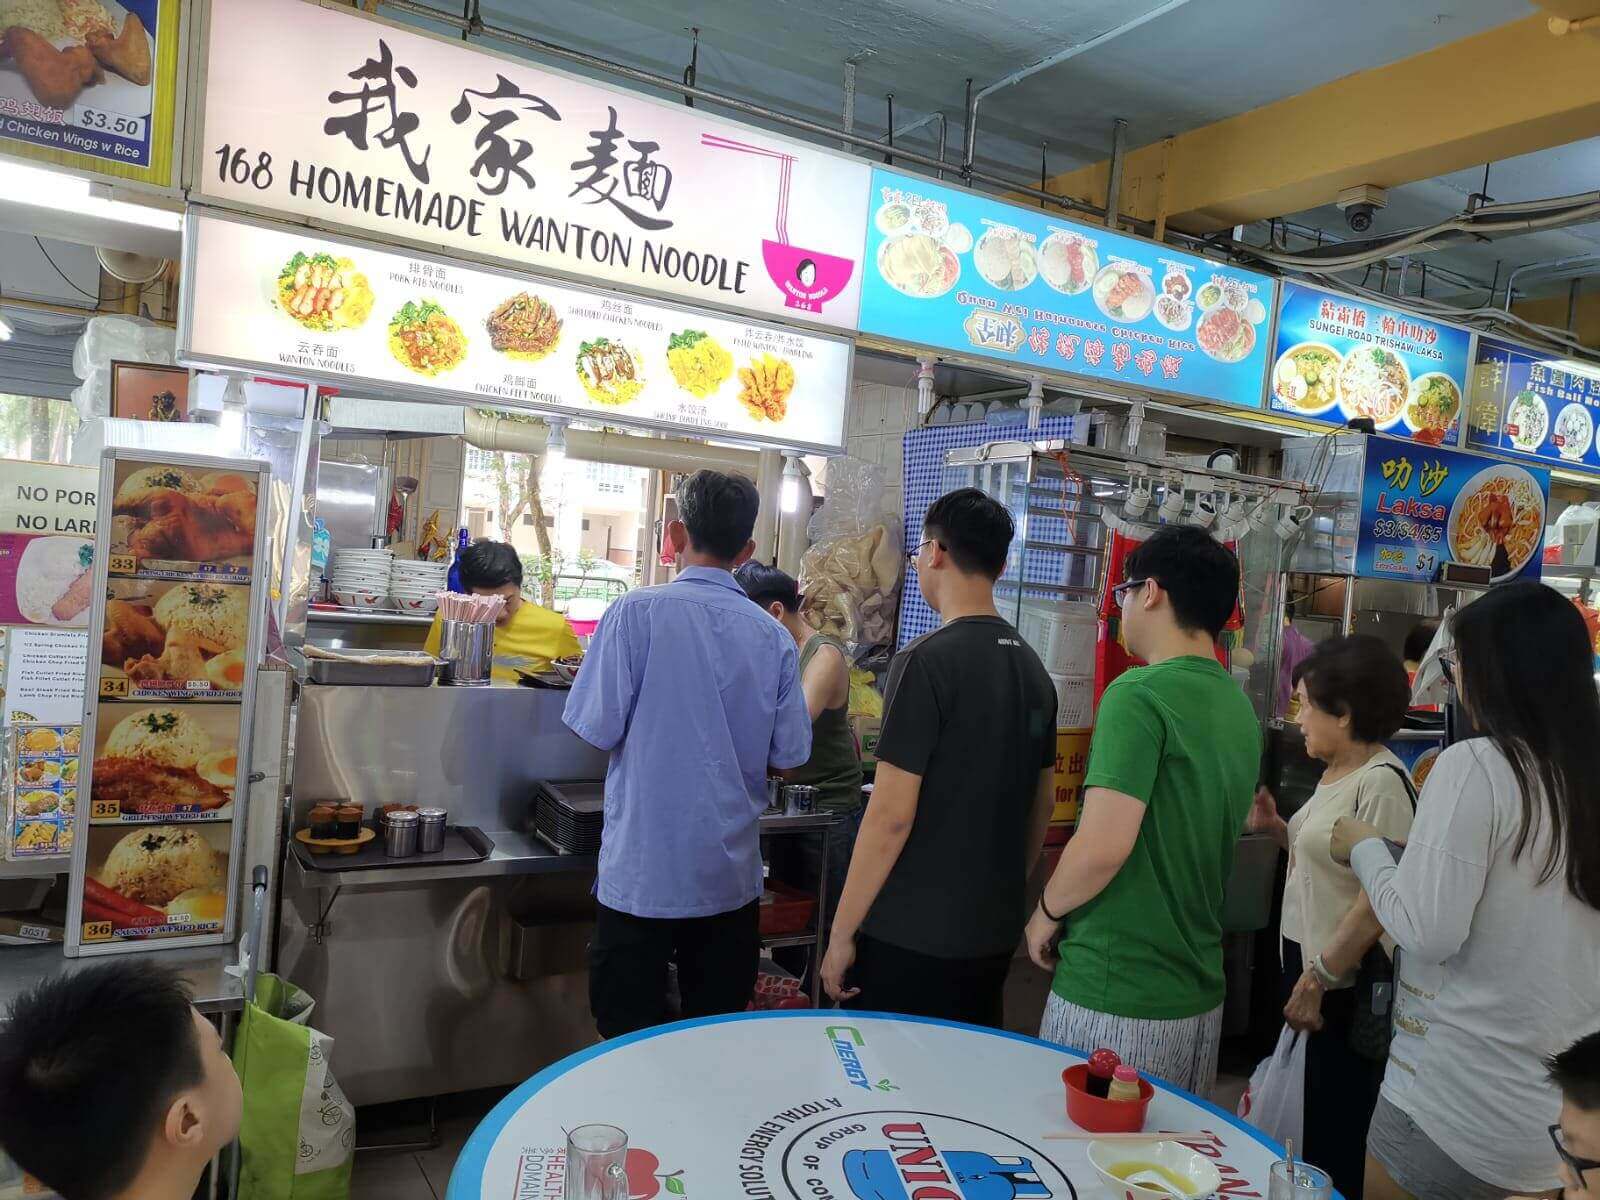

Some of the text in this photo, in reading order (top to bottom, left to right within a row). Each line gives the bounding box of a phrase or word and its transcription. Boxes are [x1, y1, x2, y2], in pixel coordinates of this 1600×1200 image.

[82, 110, 138, 135] $3.50
[7, 120, 59, 141] Chicken
[63, 131, 98, 151] Wings
[101, 142, 112, 152] w
[114, 143, 140, 158] Rice
[324, 38, 674, 230] 我家麵
[216, 144, 750, 294] 168 HOMEMADE WANTON NOODLE
[409, 262, 446, 280] 排骨面
[297, 341, 339, 358] 云吞面
[1309, 319, 1444, 361] SUNGEI ROAD TRISHAW LAKSA
[279, 353, 356, 373] WANTON NOODLES
[1527, 381, 1554, 397] Fish
[1557, 388, 1582, 403] Ball
[1381, 457, 1449, 497] 叻沙
[17, 485, 48, 502] NO
[1376, 492, 1445, 520] Laksa
[16, 515, 96, 534] NO LAR
[1374, 520, 1443, 543] $3/$4/$5
[112, 558, 134, 570] 33
[1416, 552, 1434, 571] $1
[104, 681, 126, 692] 34
[1055, 785, 1074, 803] for
[96, 803, 117, 815] 35
[88, 924, 110, 936] 36
[113, 927, 156, 937] SAUSAGE
[196, 922, 218, 931] RICE
[773, 1101, 831, 1124] TOTAL
[740, 1121, 786, 1163] ENERGY
[814, 1123, 867, 1150] GROUP
[803, 1154, 820, 1171] OF
